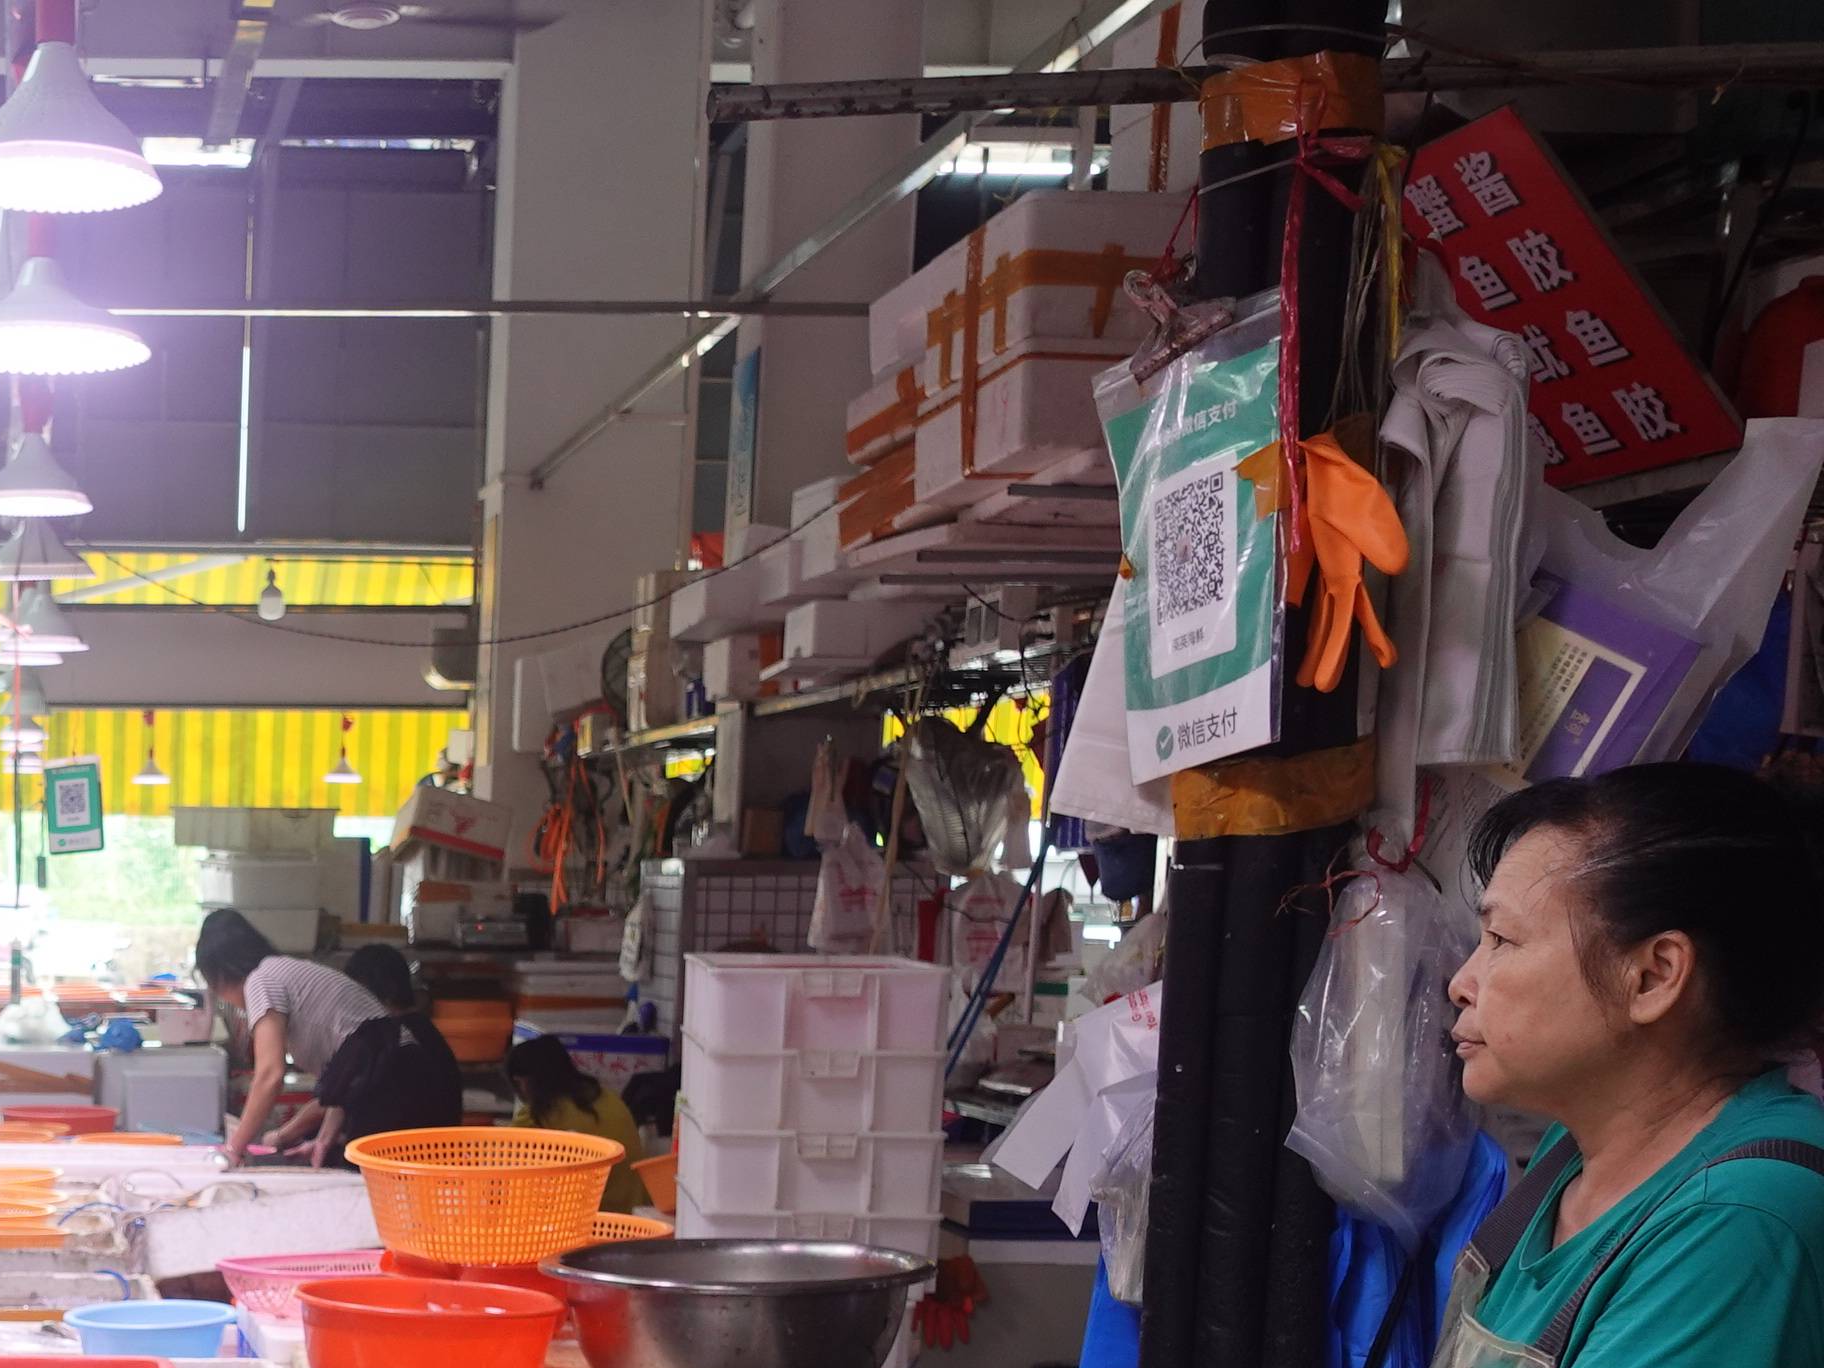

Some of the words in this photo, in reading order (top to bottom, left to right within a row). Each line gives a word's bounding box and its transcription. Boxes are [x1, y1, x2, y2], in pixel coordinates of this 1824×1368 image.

[1459, 229, 1577, 311] 鱼胶
[1177, 707, 1238, 751] 微信支付
